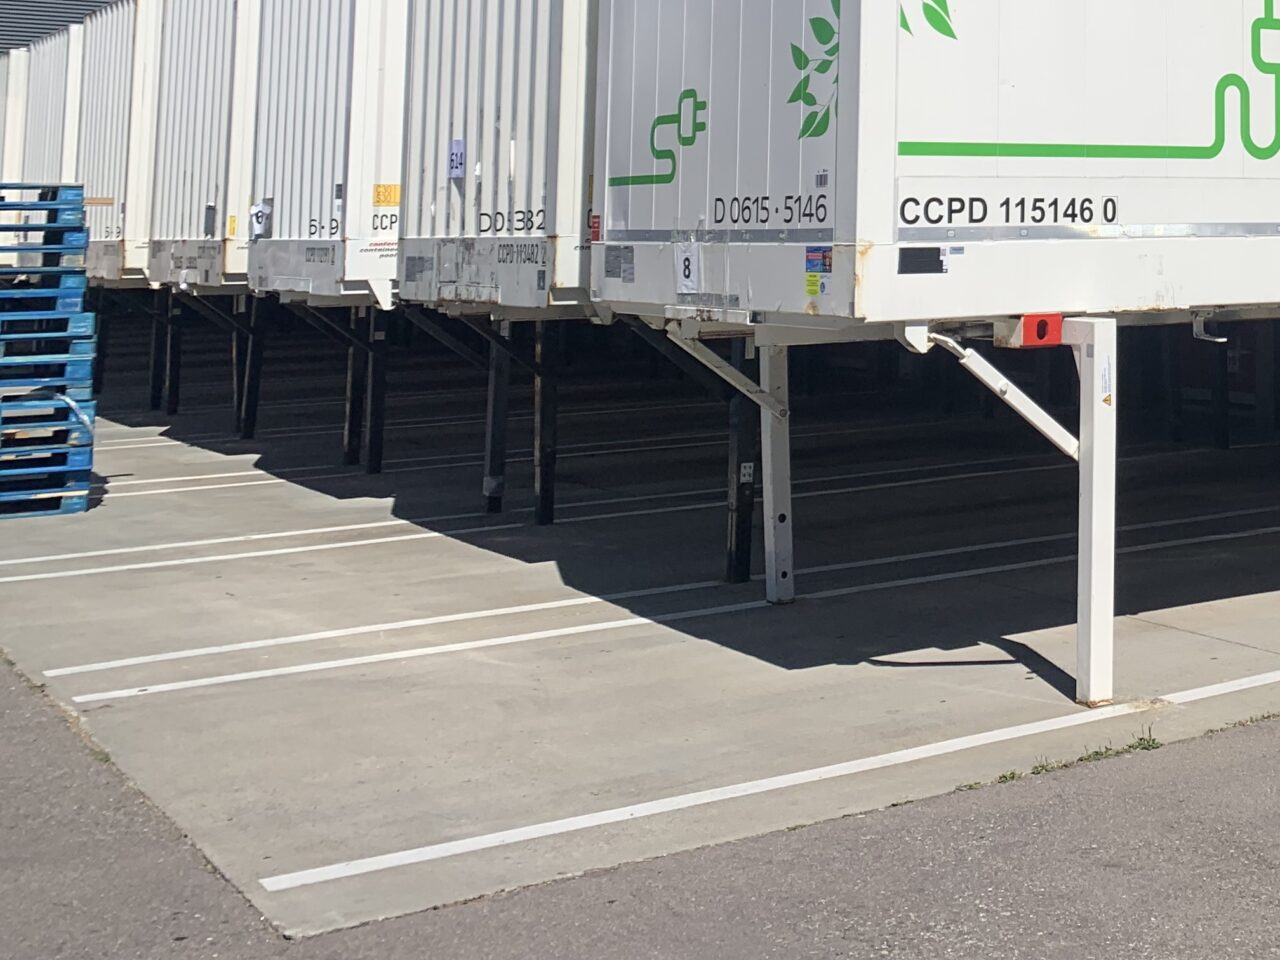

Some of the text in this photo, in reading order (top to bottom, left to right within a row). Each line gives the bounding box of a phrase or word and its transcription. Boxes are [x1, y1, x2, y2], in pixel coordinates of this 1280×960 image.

[714, 197, 725, 224] D
[899, 197, 1117, 225] CCPD 115146 0
[682, 256, 692, 279] 8
